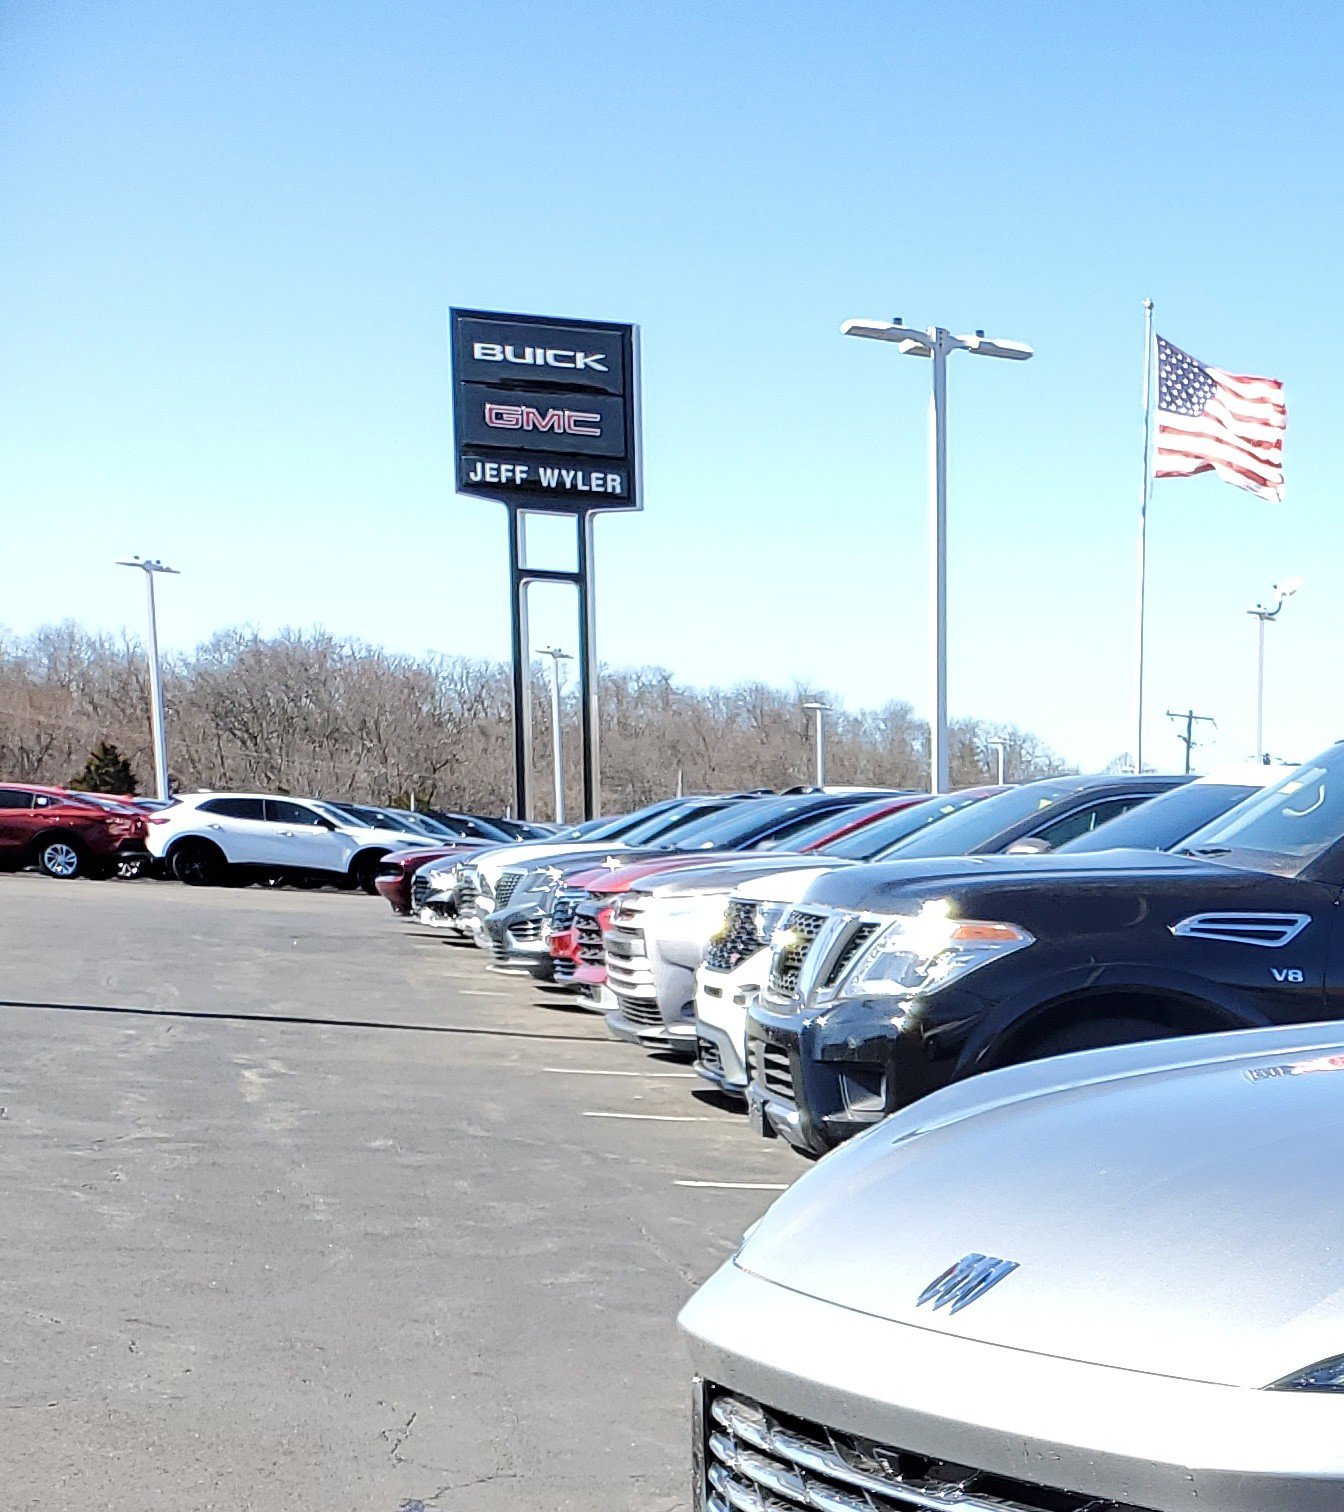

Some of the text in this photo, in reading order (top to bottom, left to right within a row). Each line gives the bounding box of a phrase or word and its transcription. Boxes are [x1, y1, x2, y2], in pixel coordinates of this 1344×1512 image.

[473, 342, 609, 372] BUICK
[485, 402, 601, 436] GMC
[469, 461, 622, 494] JEFF WYLER
[1270, 967, 1304, 982] V8
